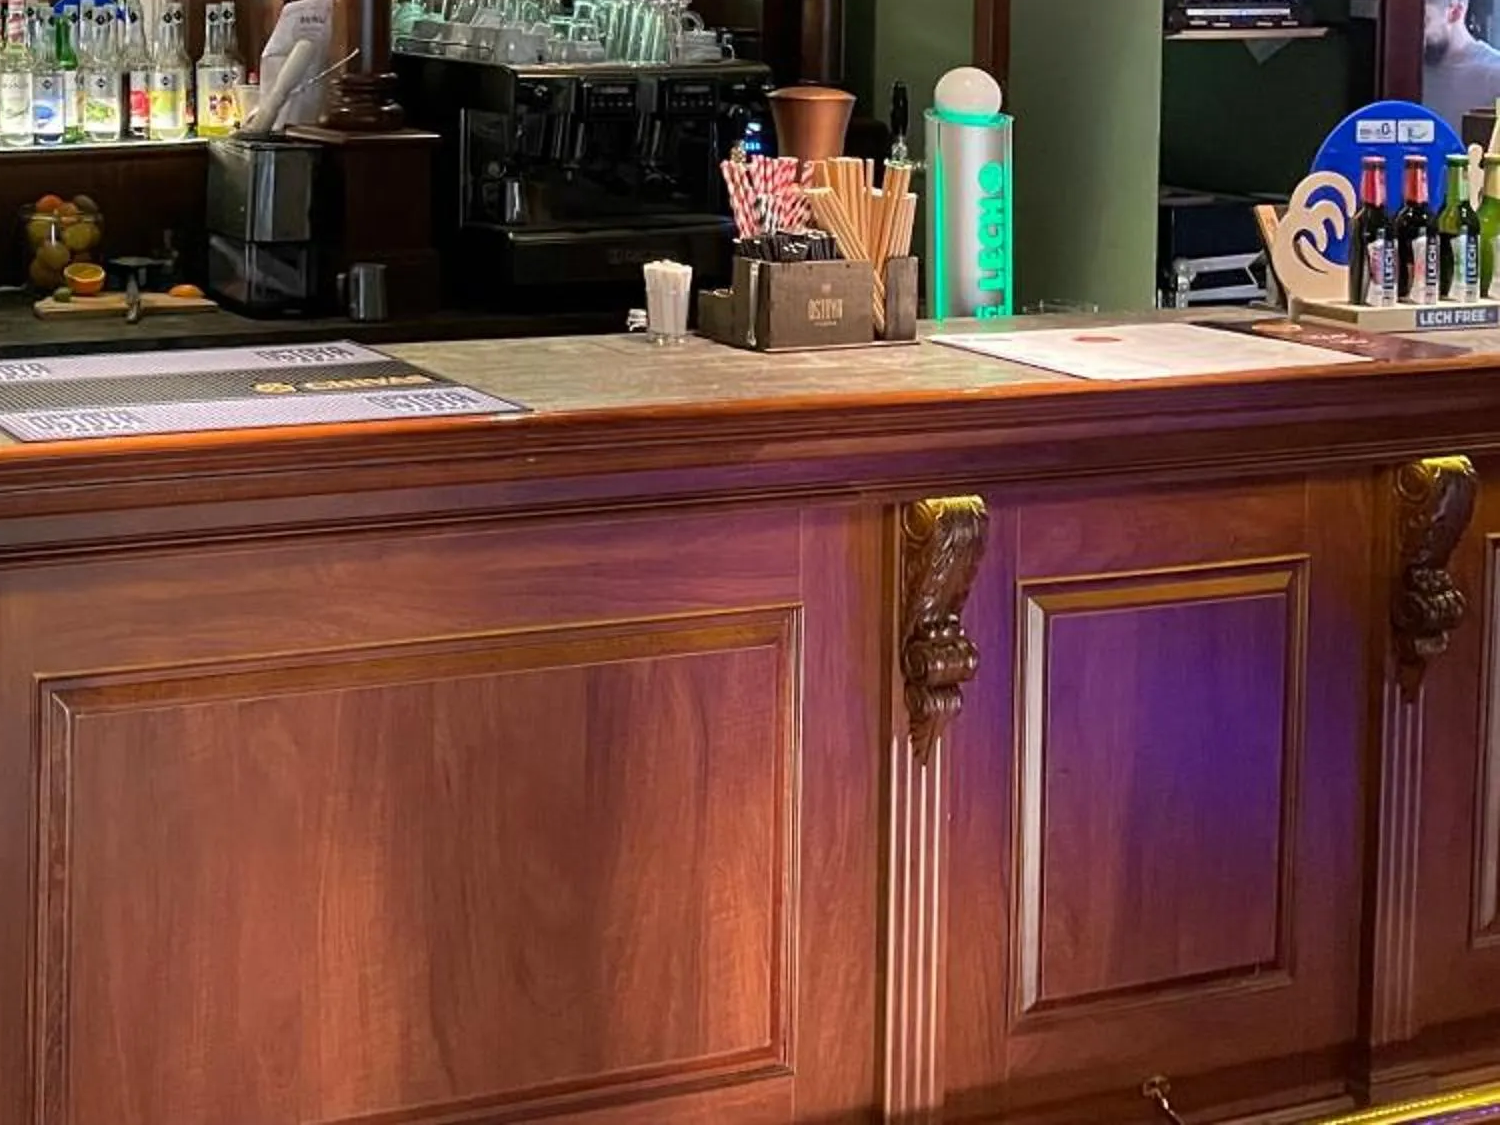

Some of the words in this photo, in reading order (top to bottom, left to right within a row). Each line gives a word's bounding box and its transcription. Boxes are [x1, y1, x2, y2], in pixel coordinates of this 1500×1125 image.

[977, 197, 1005, 292] LECH
[1419, 310, 1453, 326] LECH
[1454, 308, 1487, 324] FREE
